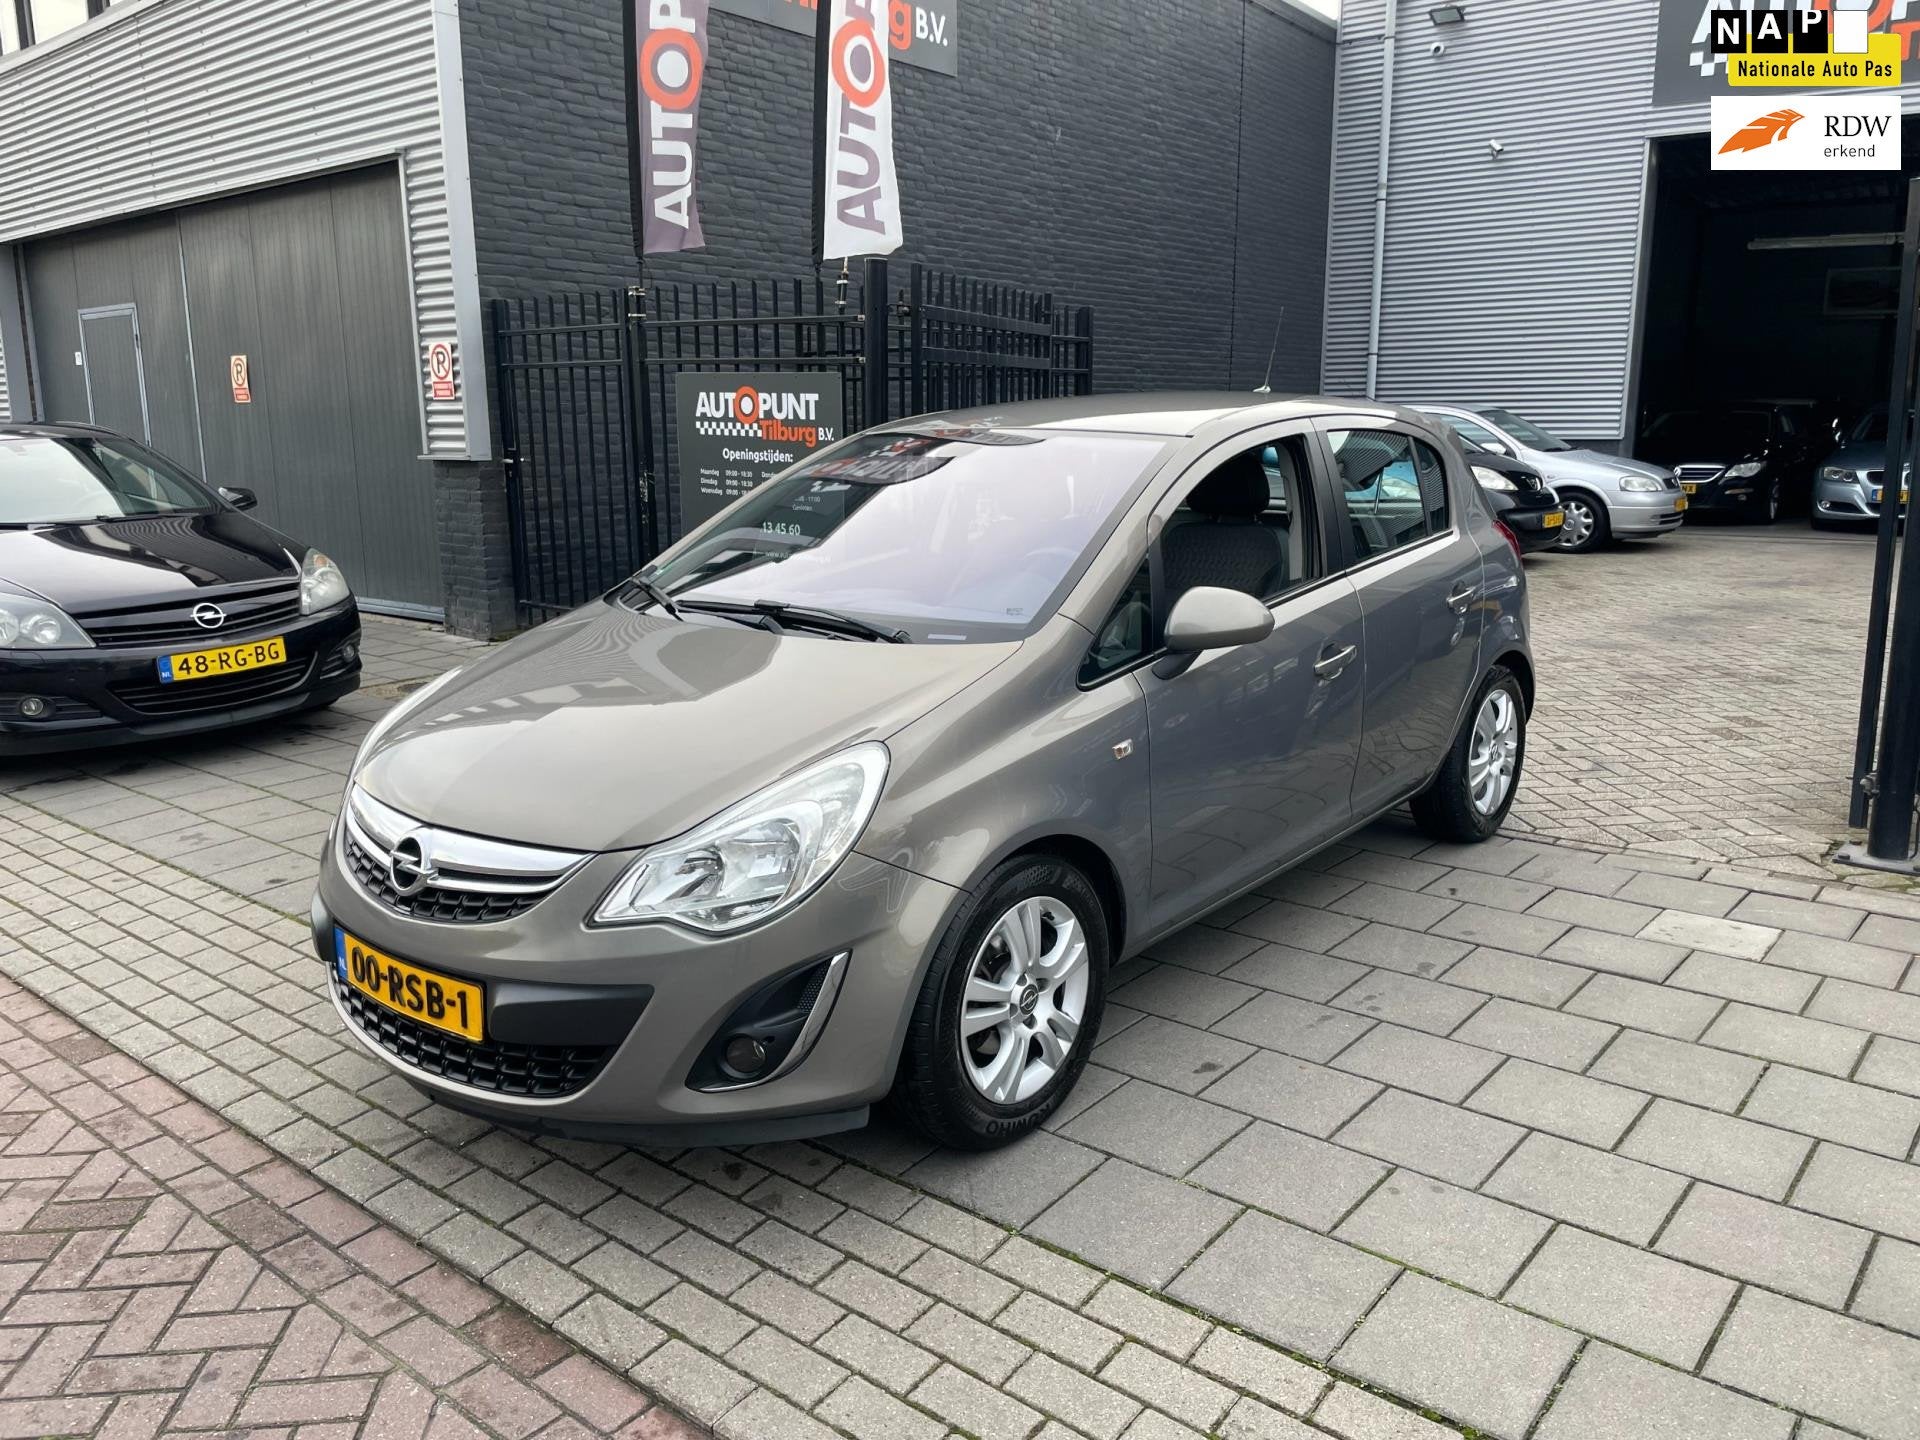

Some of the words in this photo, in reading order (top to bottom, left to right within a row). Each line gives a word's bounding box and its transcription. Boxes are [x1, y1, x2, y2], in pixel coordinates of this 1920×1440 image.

[915, 7, 948, 46] B.V.
[696, 385, 819, 424] AUTOPUNT
[759, 420, 817, 447] Tilburg
[818, 427, 834, 441] B.V.
[722, 448, 793, 463] Openingstijden:
[178, 642, 280, 675] 48-RG-BG
[351, 946, 469, 1030] 00-RSB-1
